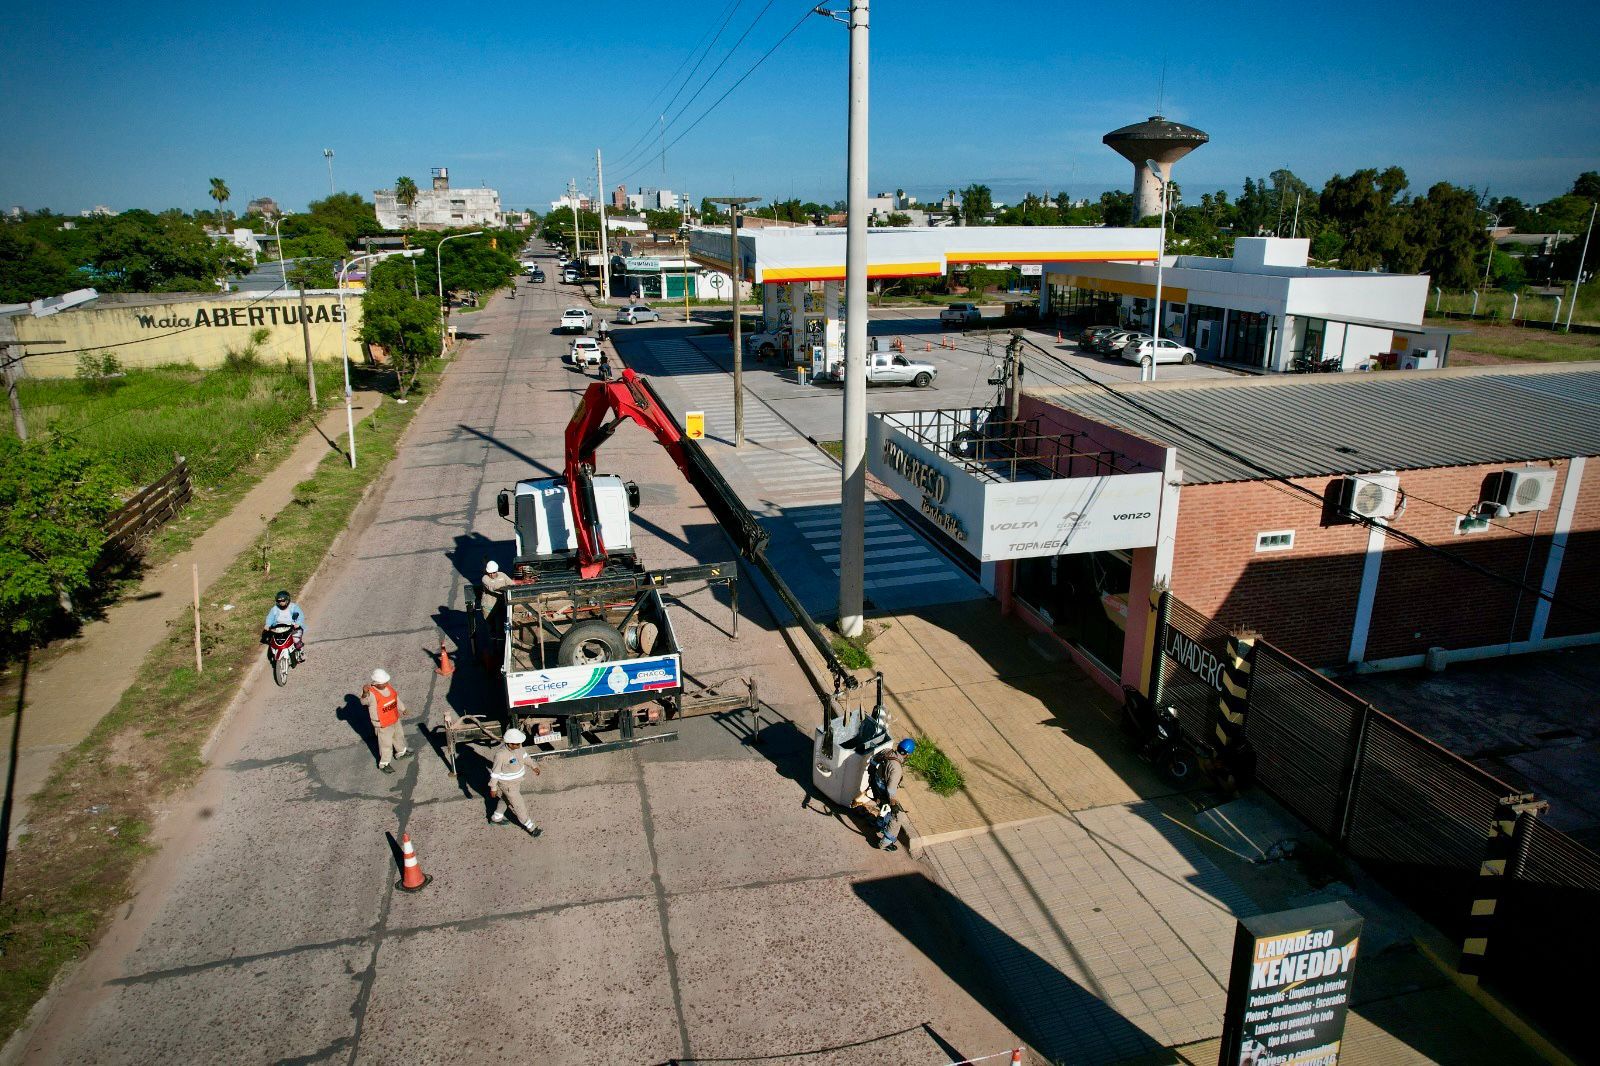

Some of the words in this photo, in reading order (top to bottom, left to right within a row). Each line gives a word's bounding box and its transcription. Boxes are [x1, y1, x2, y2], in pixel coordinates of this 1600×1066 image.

[136, 313, 192, 328] Maia
[195, 304, 347, 327] ABERTURAS
[990, 521, 1039, 531] VOLTA
[1009, 539, 1069, 551] TOPMEGA
[638, 670, 666, 679] CHACO
[524, 681, 568, 693] SECHEEP
[1257, 929, 1334, 959] LAVADERO
[1251, 944, 1356, 990] KENEDDY
[1249, 991, 1286, 1008] Polarizados
[1288, 985, 1315, 1000] Limpieza
[1315, 983, 1323, 995] de
[1271, 1001, 1312, 1018] Abrillantados
[1254, 1021, 1279, 1036] Lavados
[1288, 1013, 1312, 1029] general
[1312, 1012, 1320, 1024] de
[1320, 1009, 1334, 1022] todo
[1280, 1033, 1288, 1045] de
